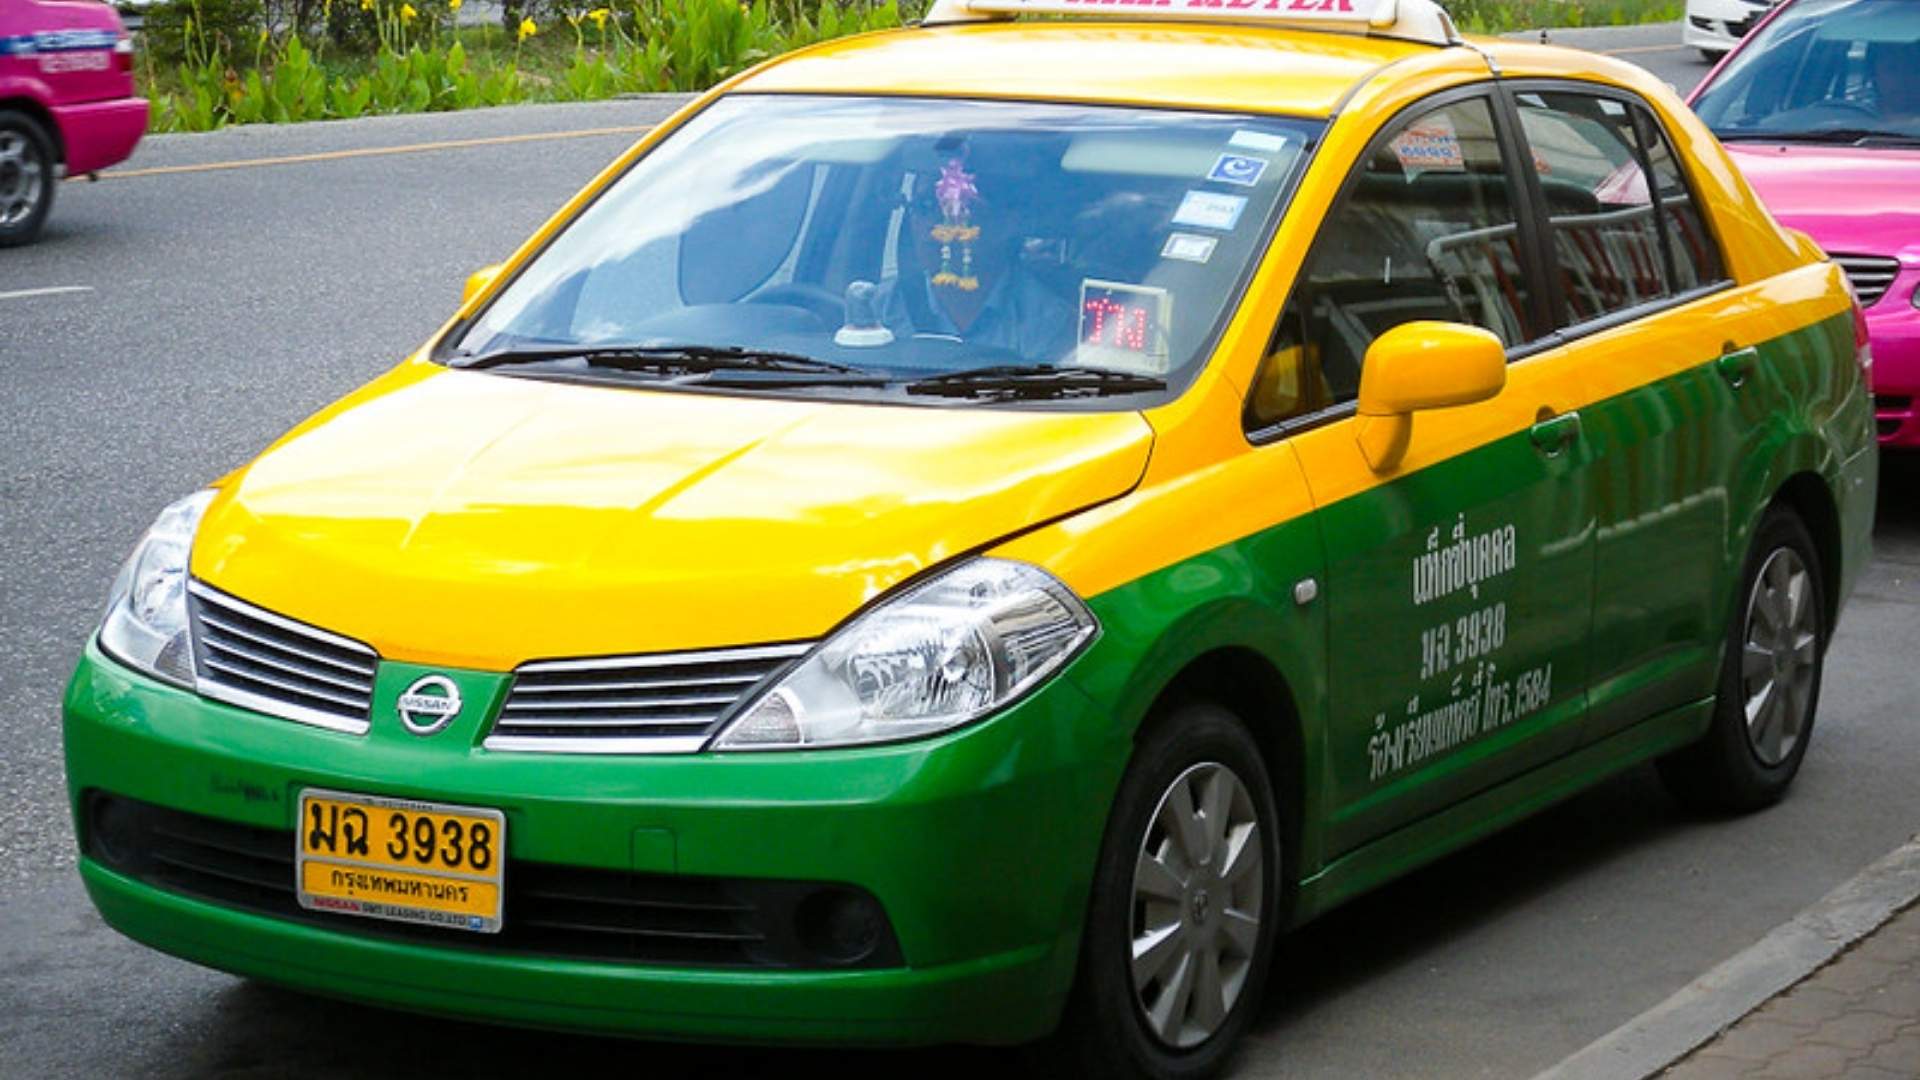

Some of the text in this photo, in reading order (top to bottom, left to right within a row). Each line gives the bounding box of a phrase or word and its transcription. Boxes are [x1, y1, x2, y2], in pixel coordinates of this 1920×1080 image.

[1086, 297, 1147, 350] ว่าง
[1412, 512, 1516, 605] แท็กซี่บุคคล
[1420, 602, 1506, 680] มฉ 3938
[401, 696, 455, 711] NISSAN
[310, 803, 491, 870] มฉ 3938
[332, 870, 469, 902] กรุงเทพมหานคร
[386, 905, 426, 920] LEASING
